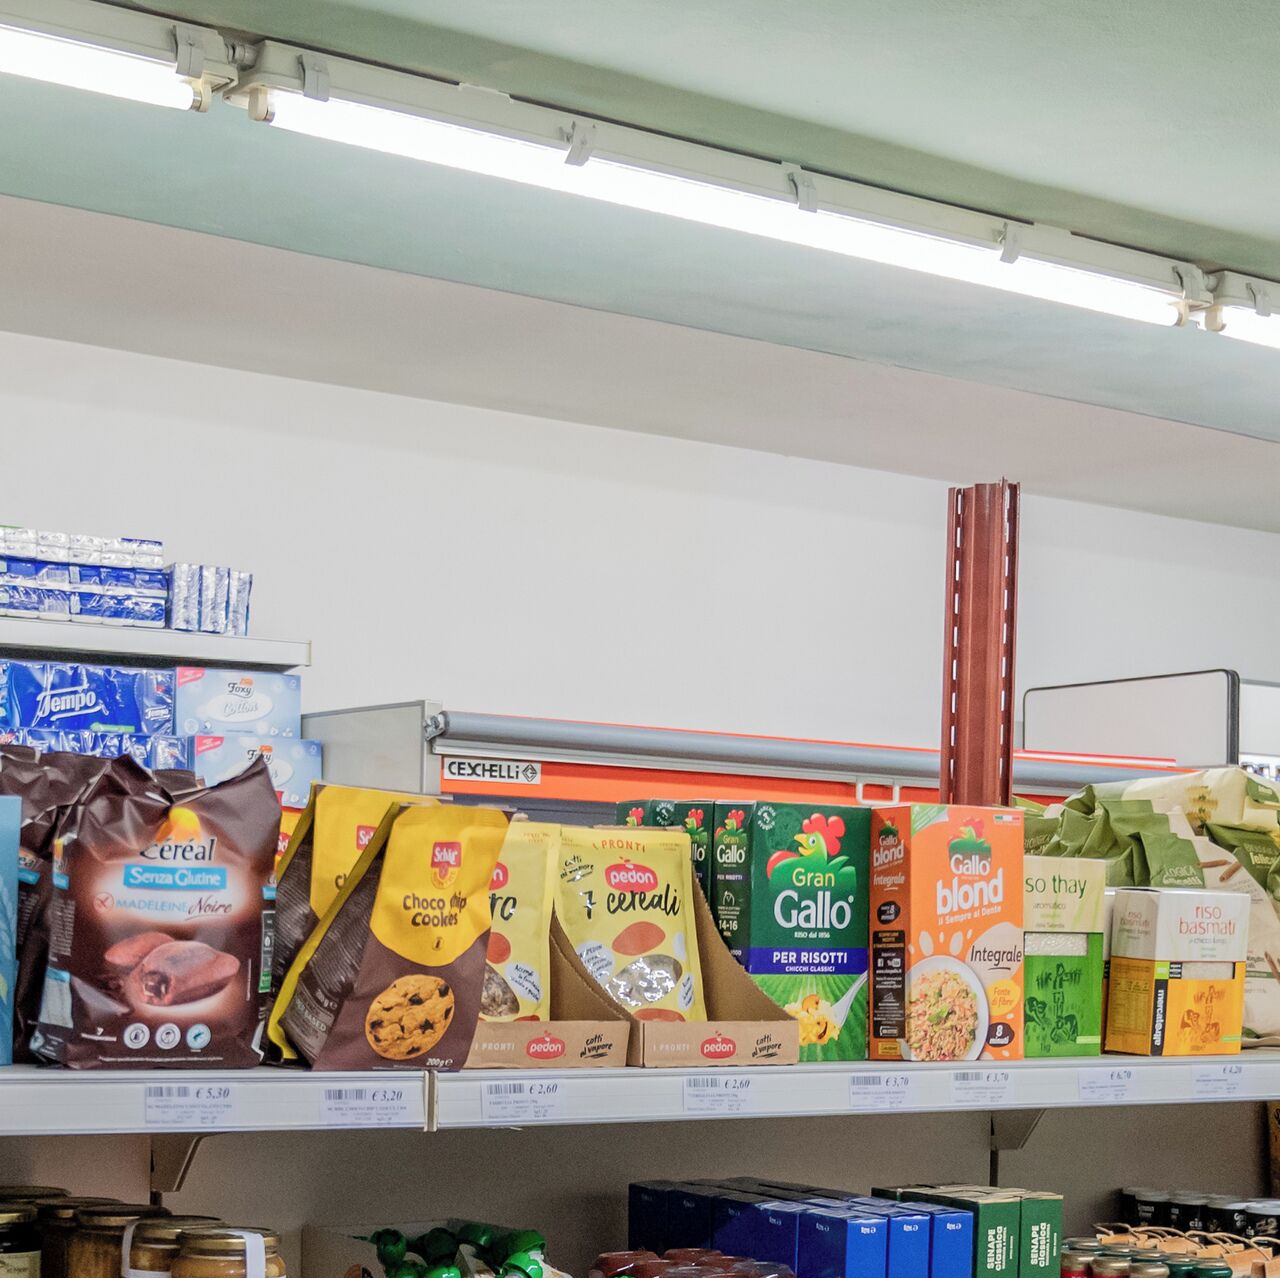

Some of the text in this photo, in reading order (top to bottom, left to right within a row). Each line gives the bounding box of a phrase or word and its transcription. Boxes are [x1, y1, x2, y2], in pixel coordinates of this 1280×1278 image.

[36, 688, 97, 724] Tempo
[717, 844, 745, 863] Gallo
[951, 855, 990, 876] Gallo
[129, 868, 222, 887] Senza Glutine
[610, 871, 654, 884] pedon
[792, 868, 835, 889] Gran
[606, 883, 680, 917] cereali
[936, 870, 1003, 915] blond
[117, 898, 233, 917] MADELEINE Noire
[774, 891, 849, 930] Gallo
[1195, 905, 1221, 920] riso
[1178, 917, 1236, 936] basmati
[772, 950, 848, 965] PER RISOTTI
[970, 945, 1022, 964] Integrale
[785, 965, 835, 973] CHICCHI CLASSICI
[529, 1083, 558, 1095] € 2,60
[986, 1228, 995, 1269] SENAPE
[1030, 1224, 1038, 1266] SENAPE
